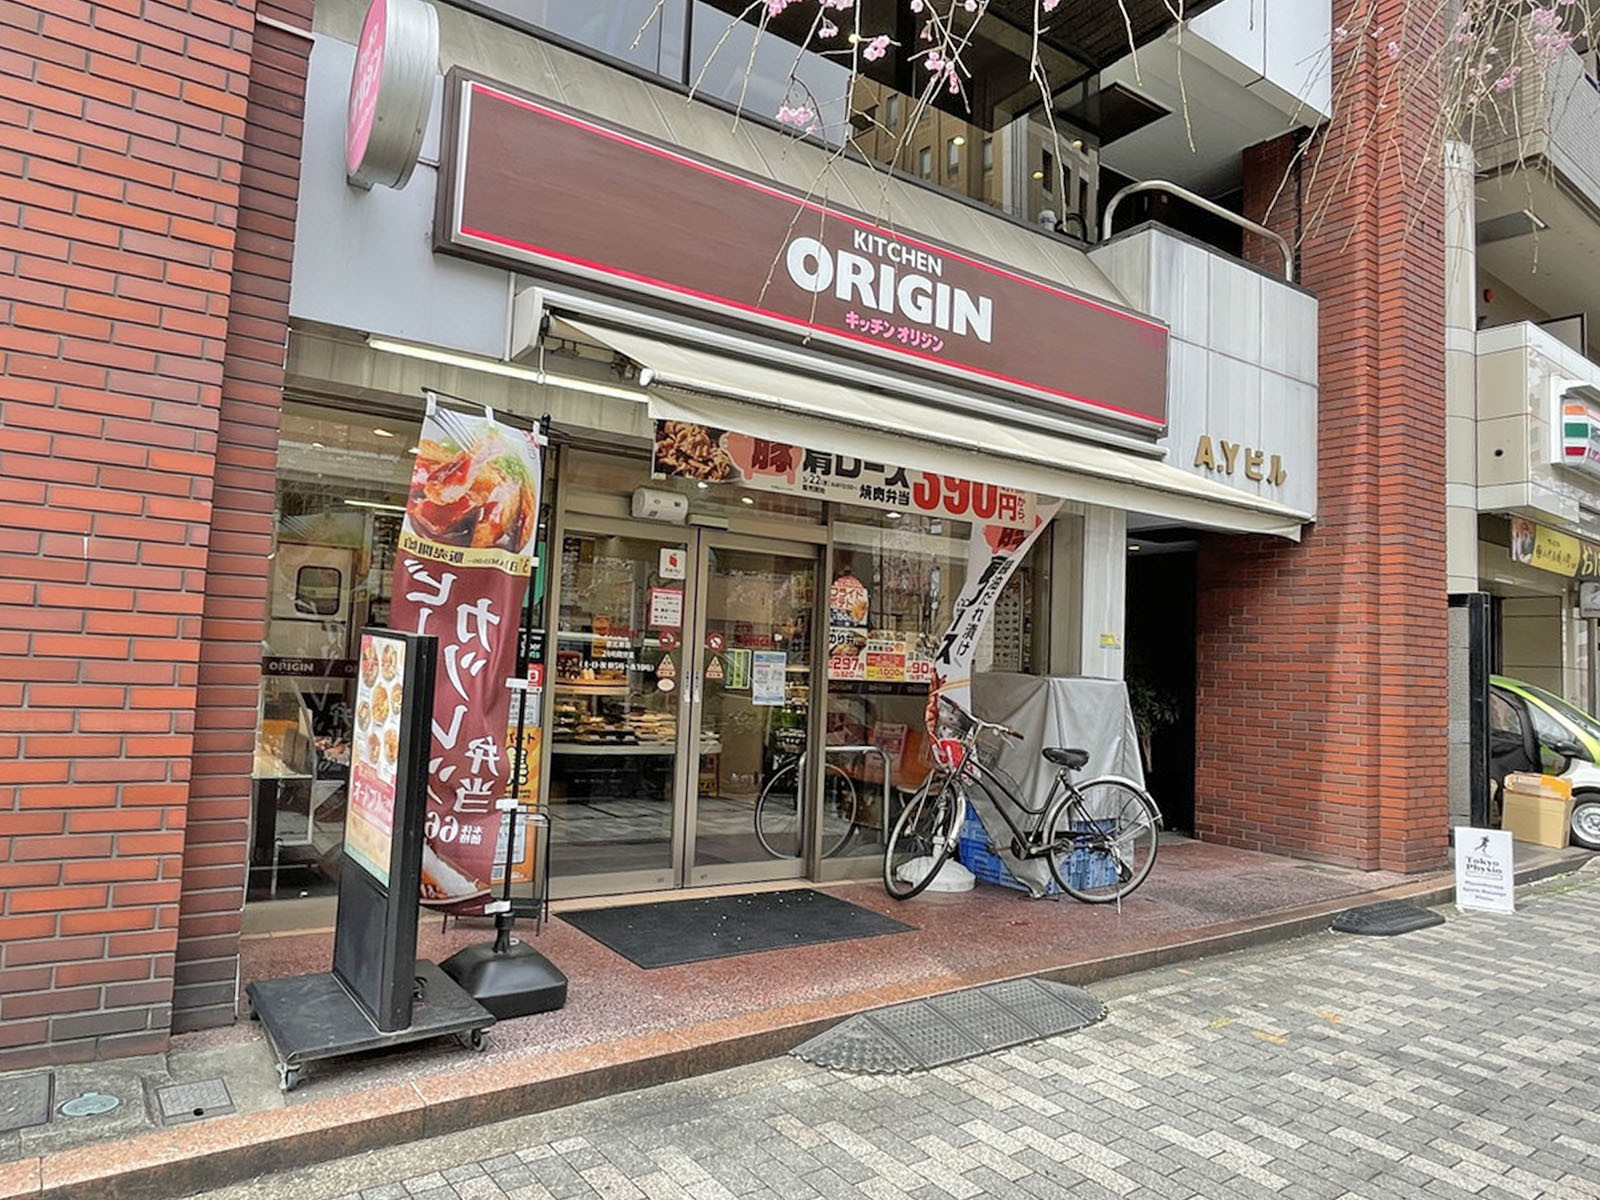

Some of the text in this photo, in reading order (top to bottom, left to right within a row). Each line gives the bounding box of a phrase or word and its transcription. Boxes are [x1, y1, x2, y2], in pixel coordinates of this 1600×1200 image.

[854, 229, 943, 277] KITCHEN
[786, 237, 993, 343] ORIGIN
[859, 484, 910, 506] 焼肉弁当
[269, 661, 314, 672] ORIGIN
[1465, 856, 1500, 868] Tokyo
